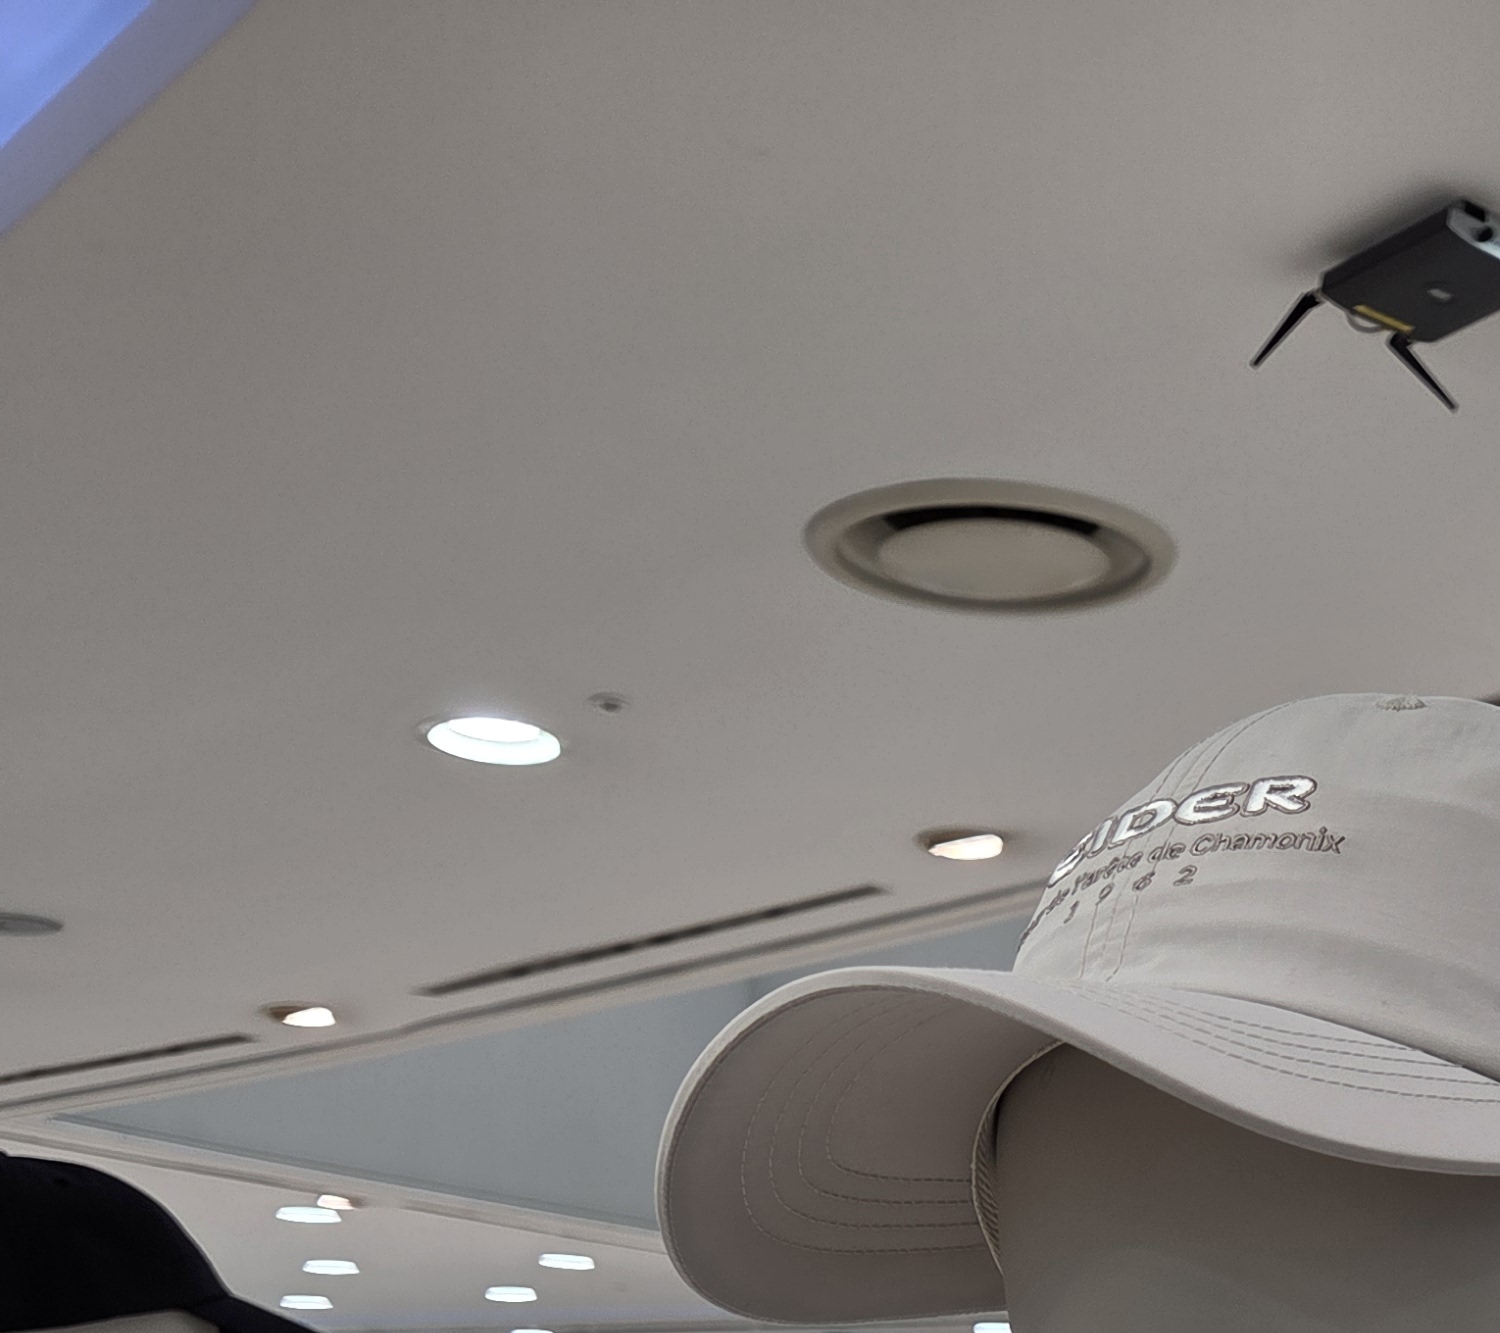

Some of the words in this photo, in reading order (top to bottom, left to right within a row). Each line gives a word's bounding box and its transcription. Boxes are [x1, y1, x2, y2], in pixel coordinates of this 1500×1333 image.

[1047, 774, 1318, 889] EIDER
[1147, 842, 1187, 864] de
[1189, 827, 1347, 857] Chamonix
